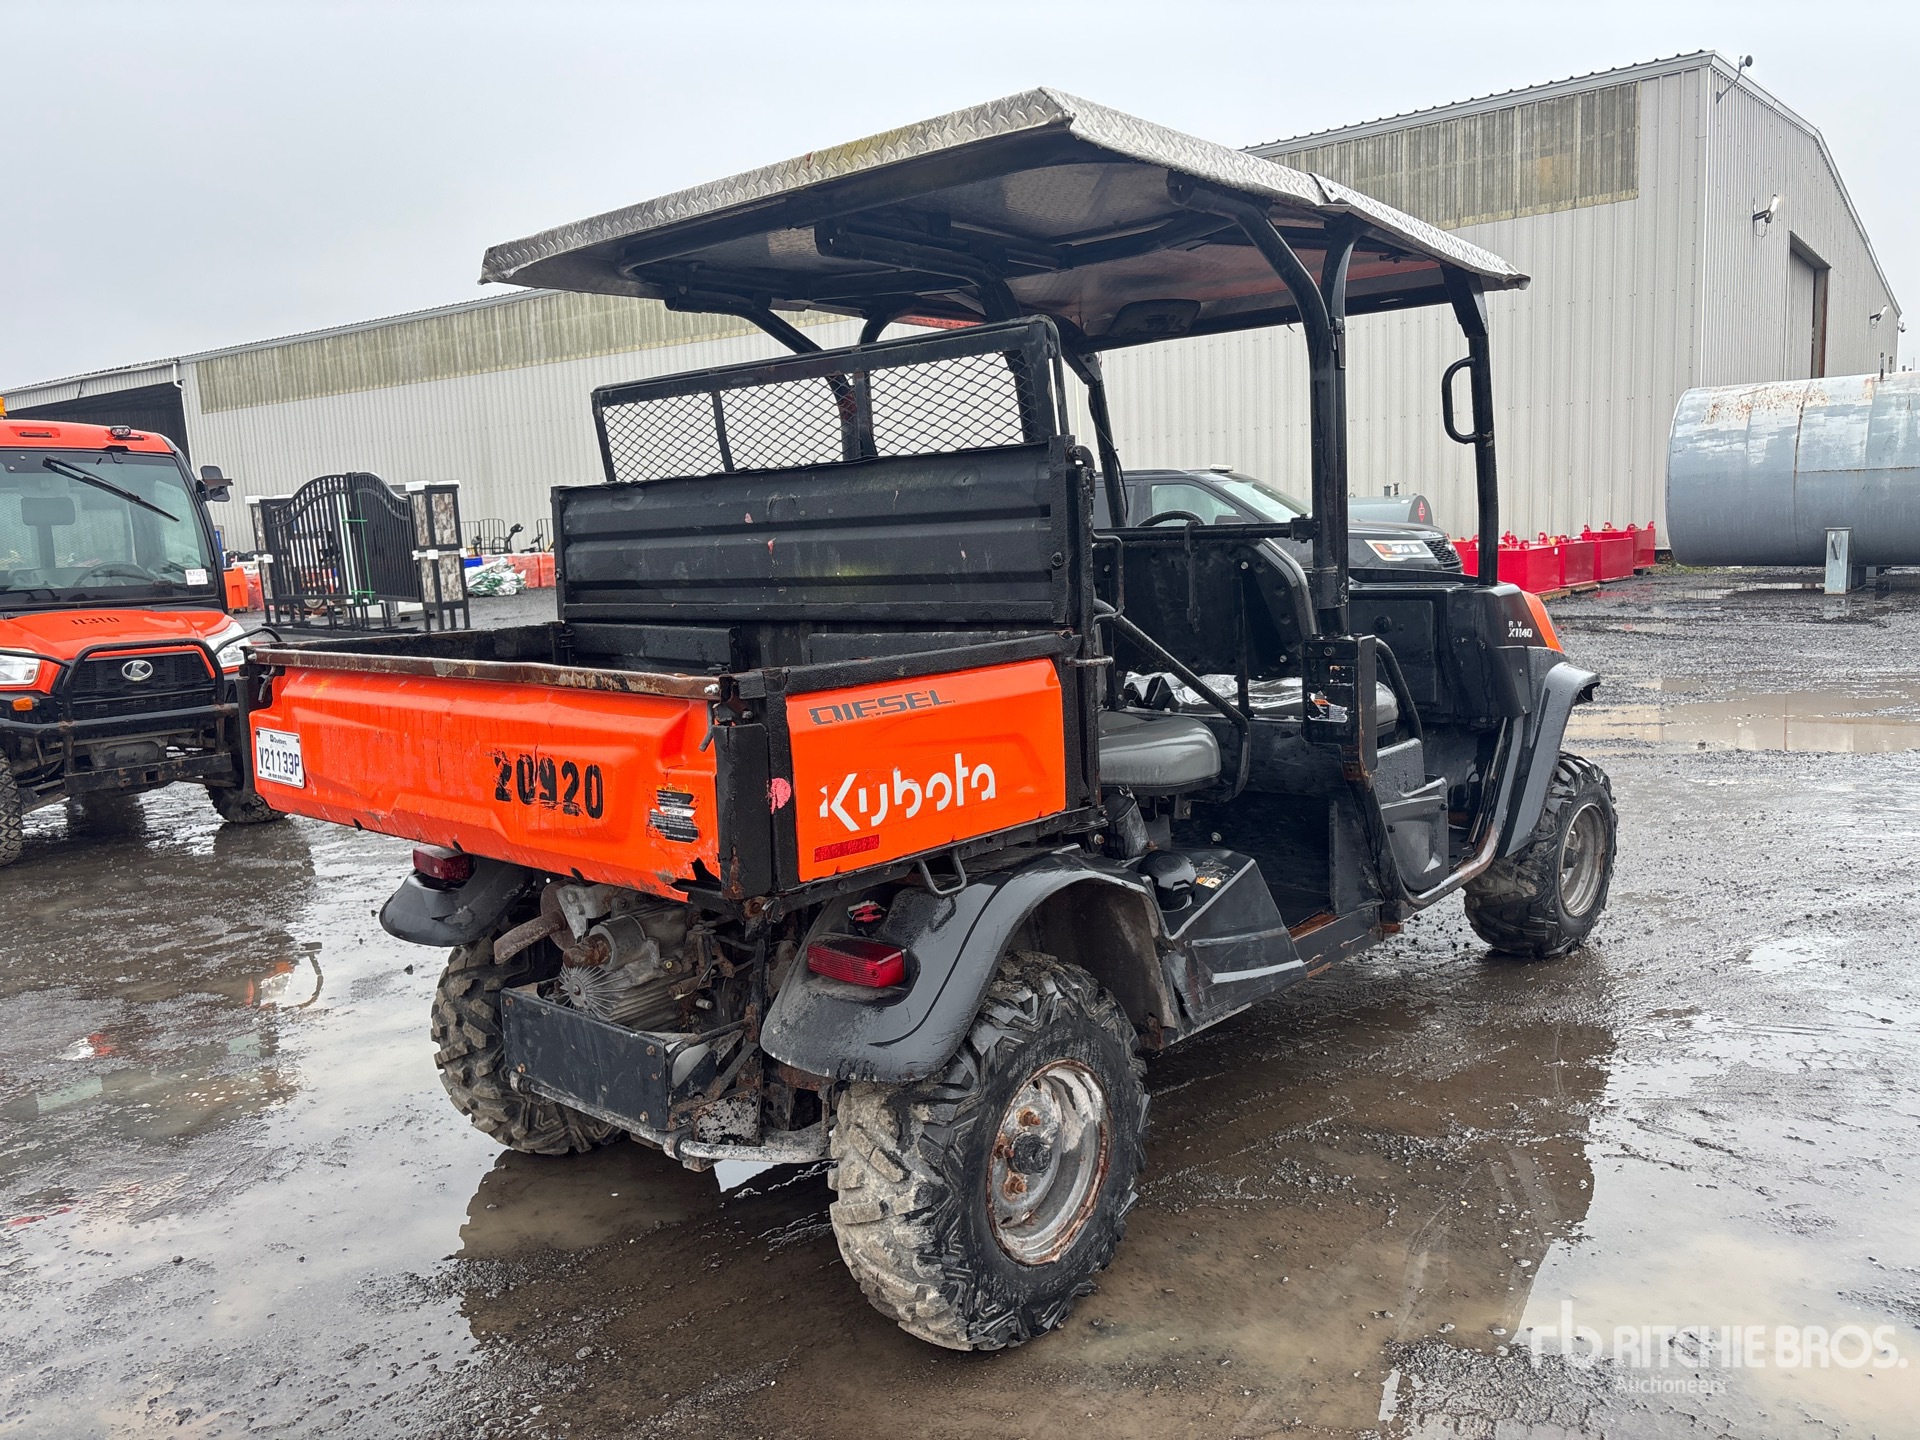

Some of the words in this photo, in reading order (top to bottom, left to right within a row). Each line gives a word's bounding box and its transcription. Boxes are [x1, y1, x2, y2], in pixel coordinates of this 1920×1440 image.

[809, 690, 955, 725] DIESEL
[493, 749, 604, 819] 20920
[819, 753, 996, 832] Kubota
